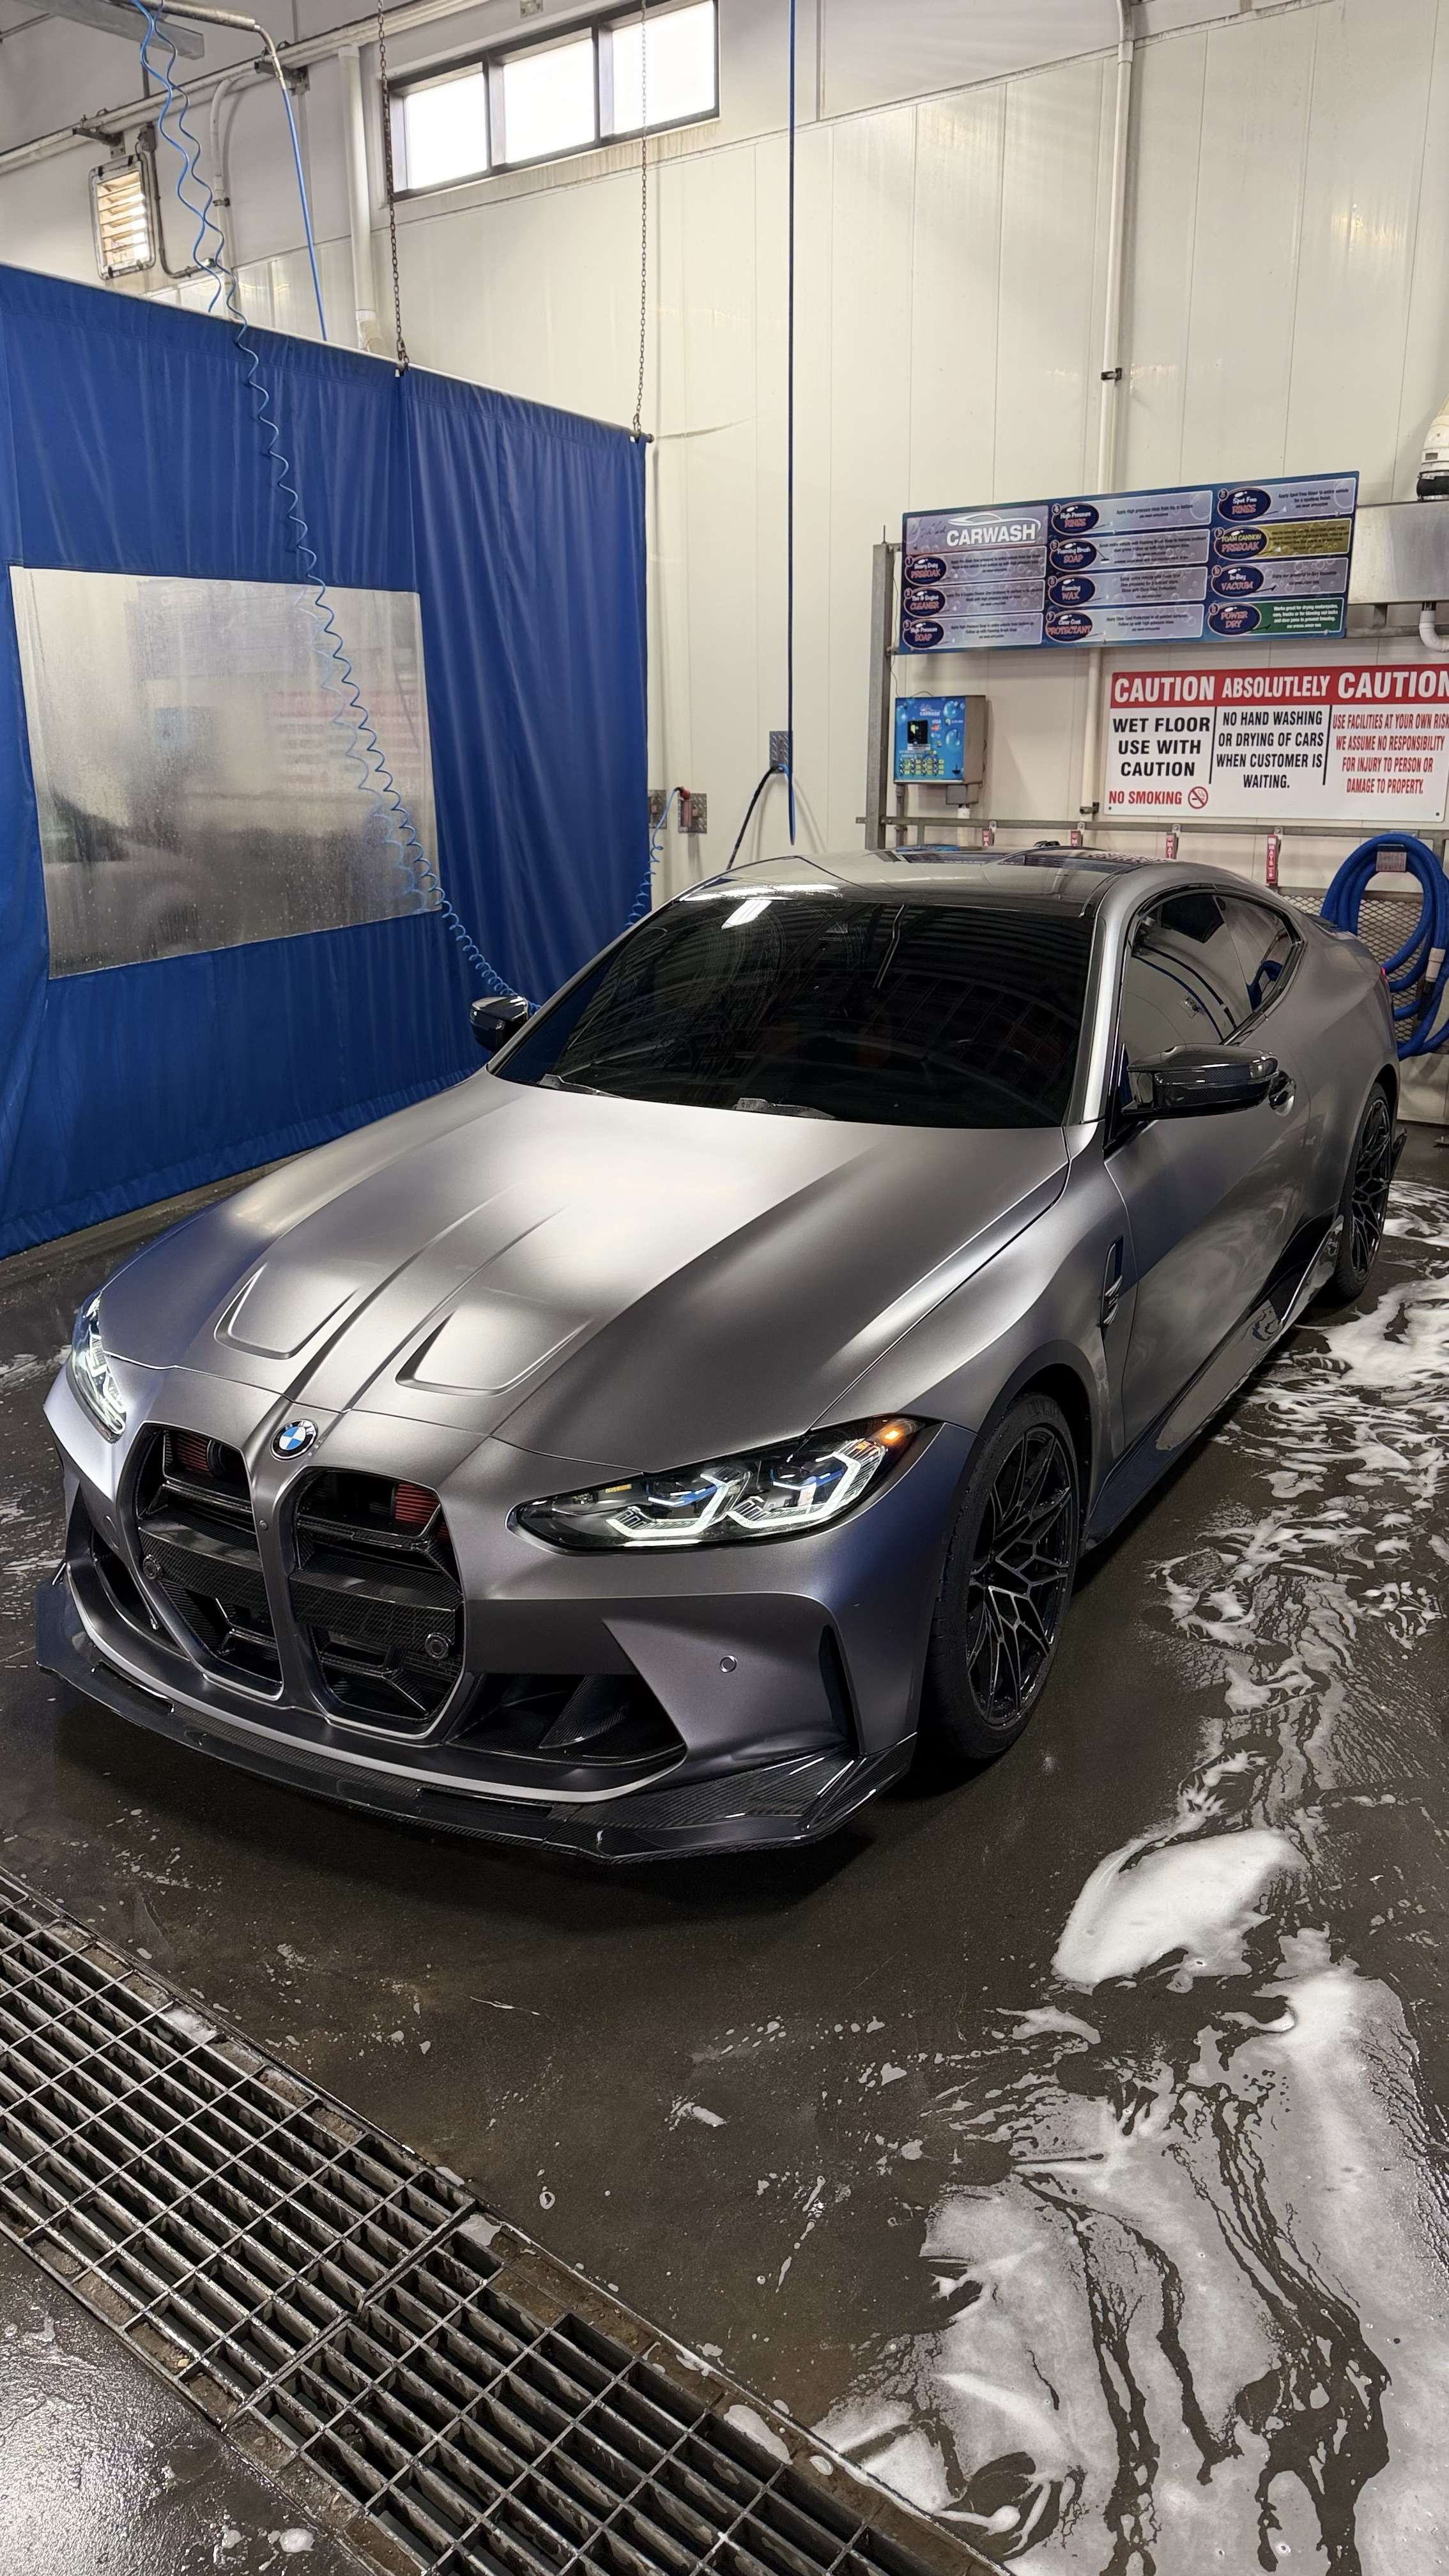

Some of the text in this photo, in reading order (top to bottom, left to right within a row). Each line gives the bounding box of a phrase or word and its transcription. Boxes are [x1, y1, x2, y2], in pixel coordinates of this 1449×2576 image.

[1232, 504, 1256, 514] RINSE
[1064, 518, 1086, 528] RINSE
[947, 523, 1035, 547] CARWASH
[1222, 541, 1259, 553] PRESOAK
[1063, 554, 1084, 564] SOAP
[910, 569, 941, 579] PRESOAK
[1222, 581, 1254, 590] VACUUM
[1061, 592, 1080, 600] WAX
[910, 601, 939, 610] CLEANER
[1220, 611, 1248, 620] POWER
[1047, 625, 1091, 635] PROTECTANT
[1225, 620, 1243, 628] DRY
[914, 633, 932, 642] SOAP
[1115, 671, 1449, 703] CAUTION ABSOLUTLELY CAUTION
[1113, 717, 1210, 732] WET FLOOR
[1223, 710, 1322, 726] NO HAND WASHING
[1333, 714, 1346, 729] USE
[1347, 714, 1383, 729] FACILITIES
[1384, 714, 1393, 729] AT
[1395, 714, 1413, 729] YOUR
[1415, 714, 1432, 729] OWN
[1218, 732, 1324, 747] OR DRYING OF CARS
[1336, 735, 1445, 751] WE ASSUME NO RESPONSIBILITY
[1118, 740, 1201, 755] USE WITH
[1216, 754, 1322, 767] WHEN CUSTOMER IS
[1342, 757, 1433, 772] FOR INJURY TO PERSON OR
[1121, 762, 1195, 776] CAUTION
[1243, 774, 1290, 788] WAITING.
[1347, 778, 1423, 794] DAMAGE TO PROPERTY.
[1109, 791, 1182, 804] NO SMOKING
